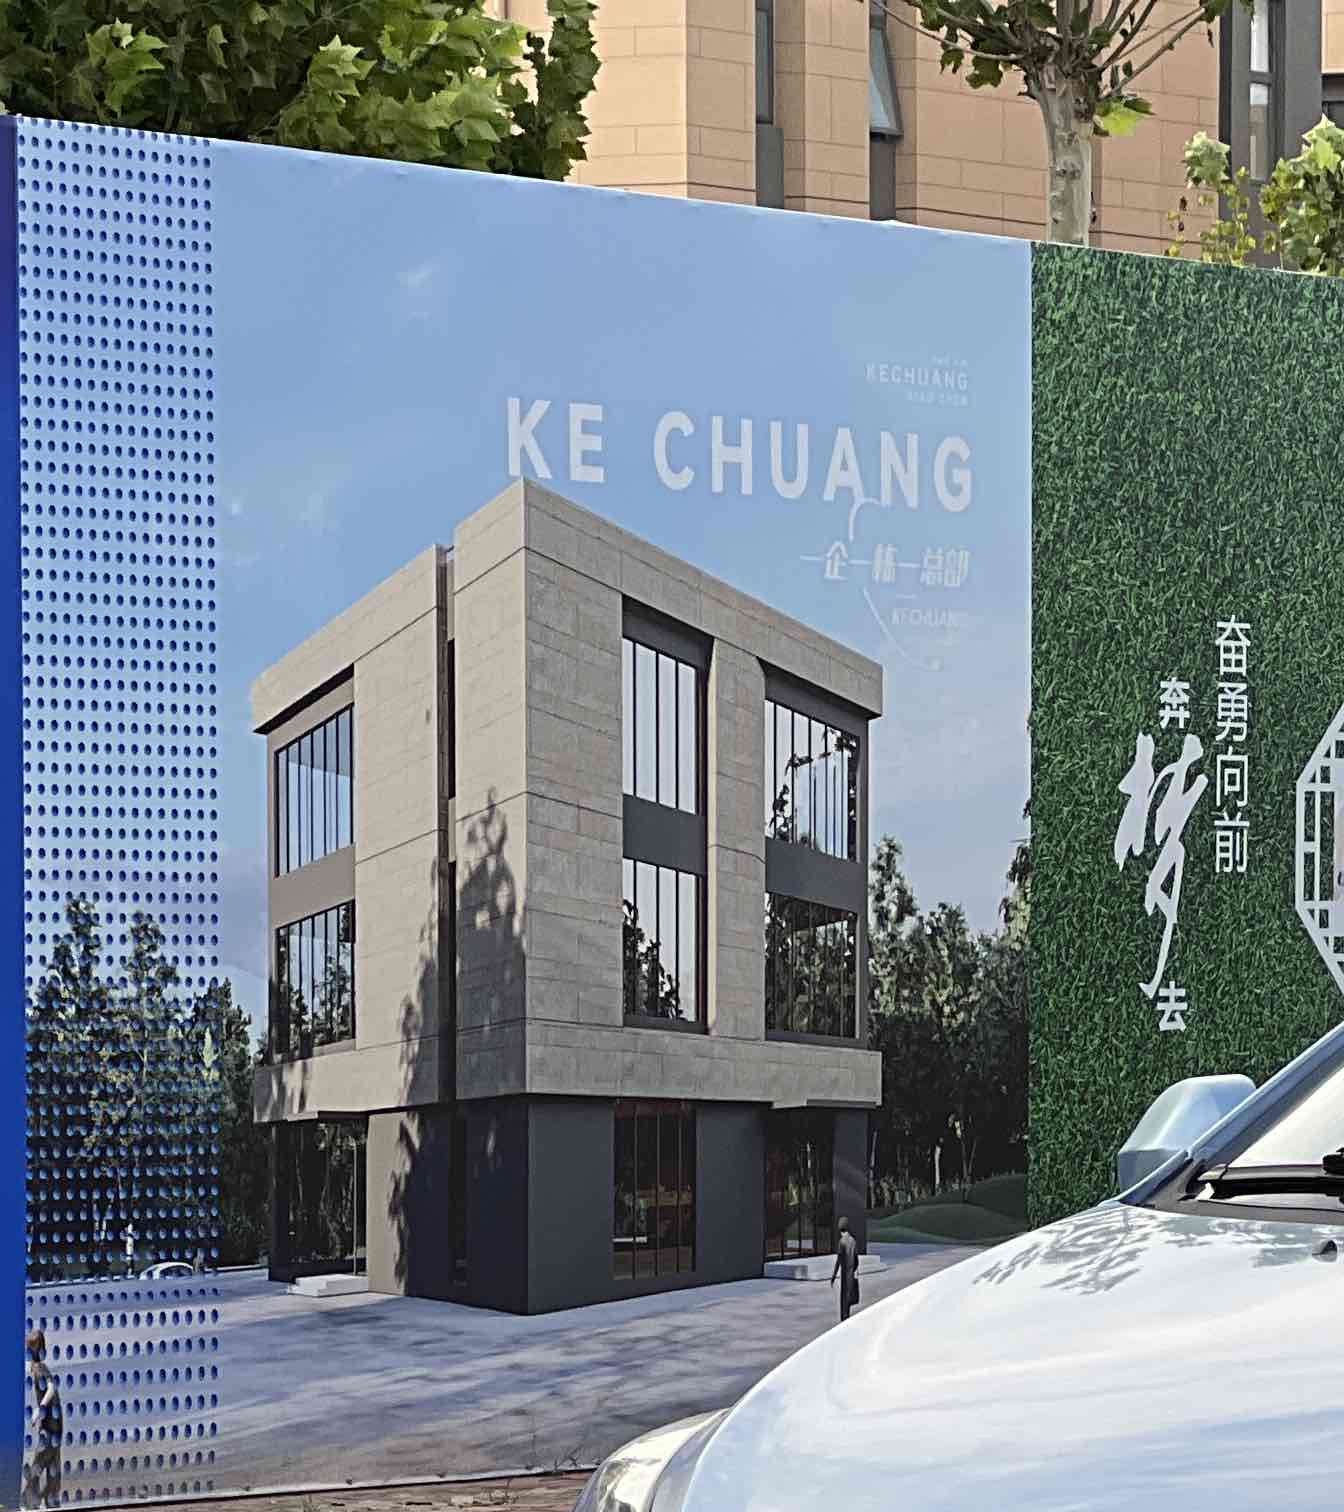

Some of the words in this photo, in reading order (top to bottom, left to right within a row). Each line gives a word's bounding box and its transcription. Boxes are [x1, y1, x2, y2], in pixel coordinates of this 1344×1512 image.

[507, 397, 606, 483] KE
[653, 411, 972, 512] CHUANG
[1214, 614, 1251, 874] 奋勇向前
